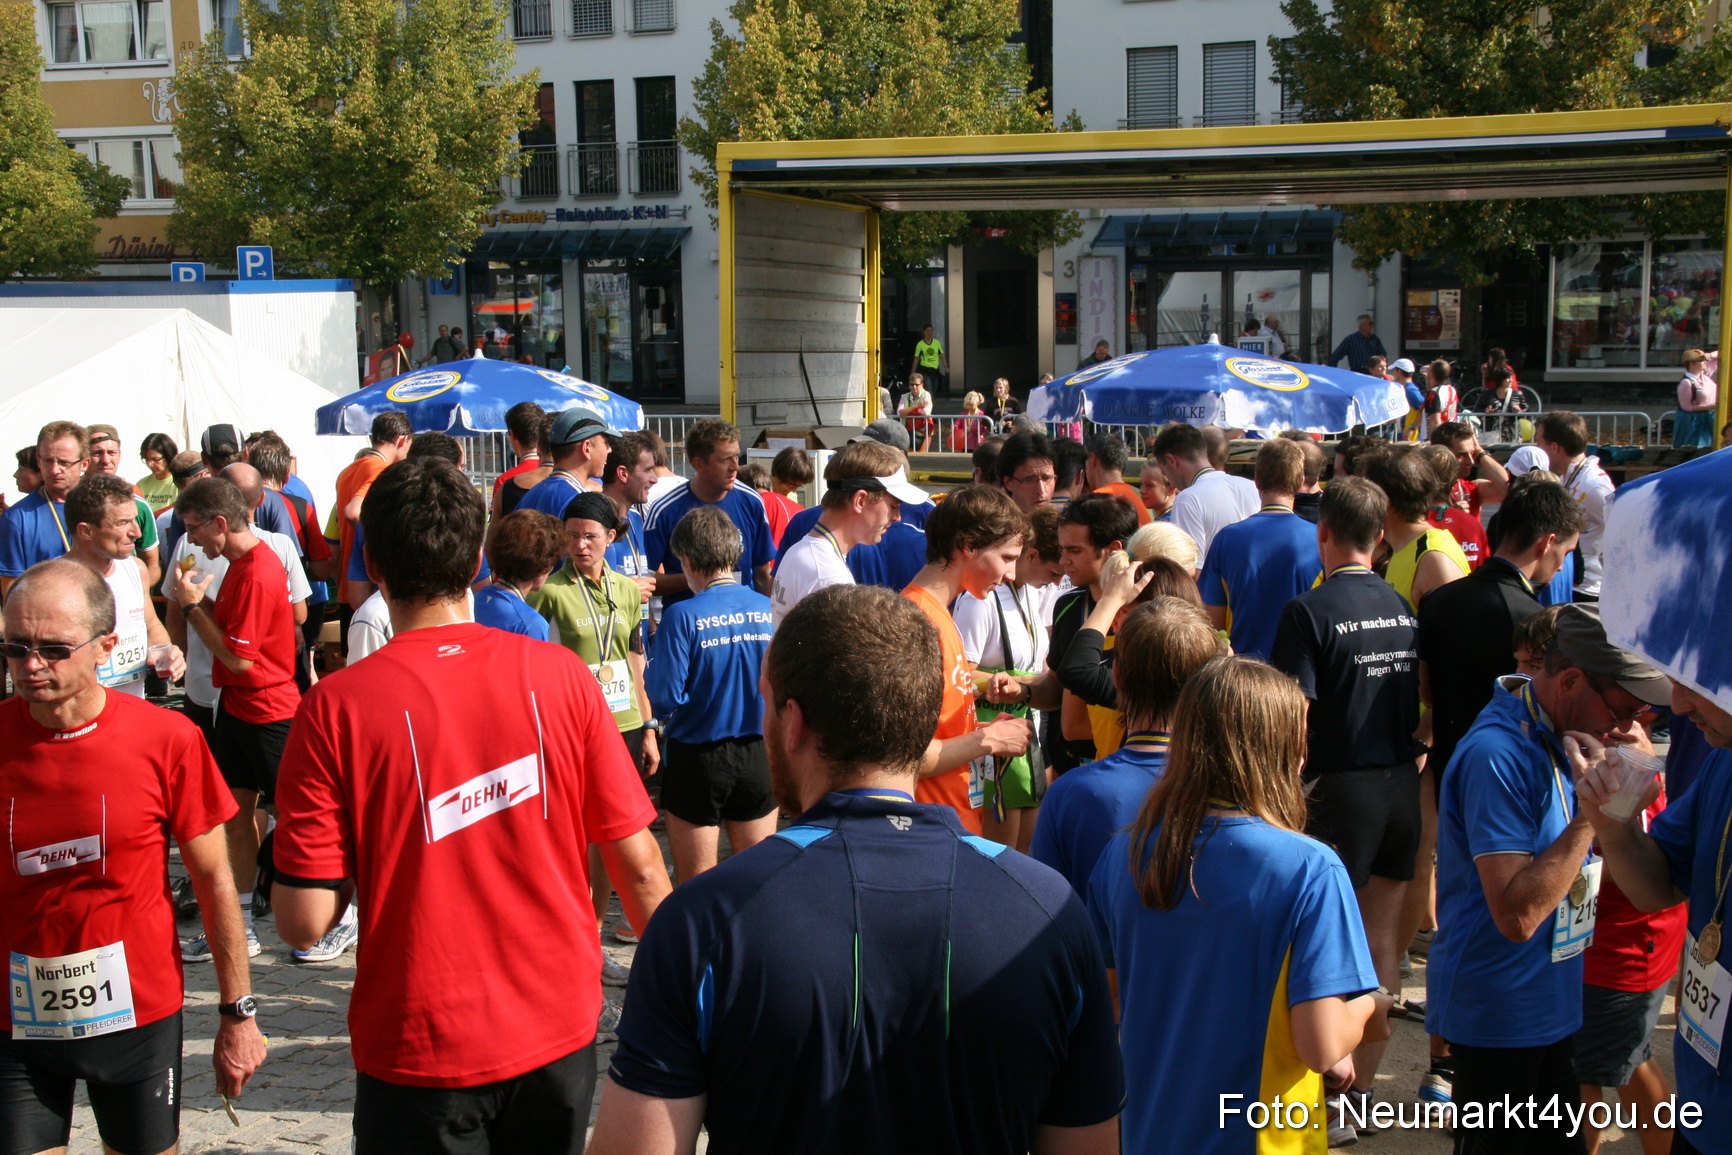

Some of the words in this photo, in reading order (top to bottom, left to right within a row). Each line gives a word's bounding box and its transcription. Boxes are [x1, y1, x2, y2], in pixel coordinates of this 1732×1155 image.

[500, 209, 546, 225] Center
[556, 207, 630, 223] Reisebüro
[633, 205, 669, 220] K+N
[246, 251, 264, 278] P
[1063, 260, 1075, 278] 3
[1242, 343, 1262, 351] HIER
[1101, 404, 1154, 418] DUNKLE
[1162, 406, 1206, 419] WOLKE
[696, 613, 745, 631] SYSCAD
[1335, 621, 1359, 635] Wir
[1361, 616, 1398, 630] machen
[1398, 615, 1411, 627] Sie
[701, 639, 719, 648] CAD
[720, 636, 731, 645] für
[117, 645, 146, 666] 3251
[1366, 666, 1391, 677] Jürgen
[1394, 662, 1410, 672] Wild
[461, 779, 508, 815] DEHN
[41, 847, 77, 865] DEHN
[35, 961, 97, 981] Norbert
[16, 986, 22, 998] B
[41, 979, 113, 1011] 2591
[1684, 969, 1721, 1020] 2537
[87, 1014, 133, 1032] PFLEIDERER
